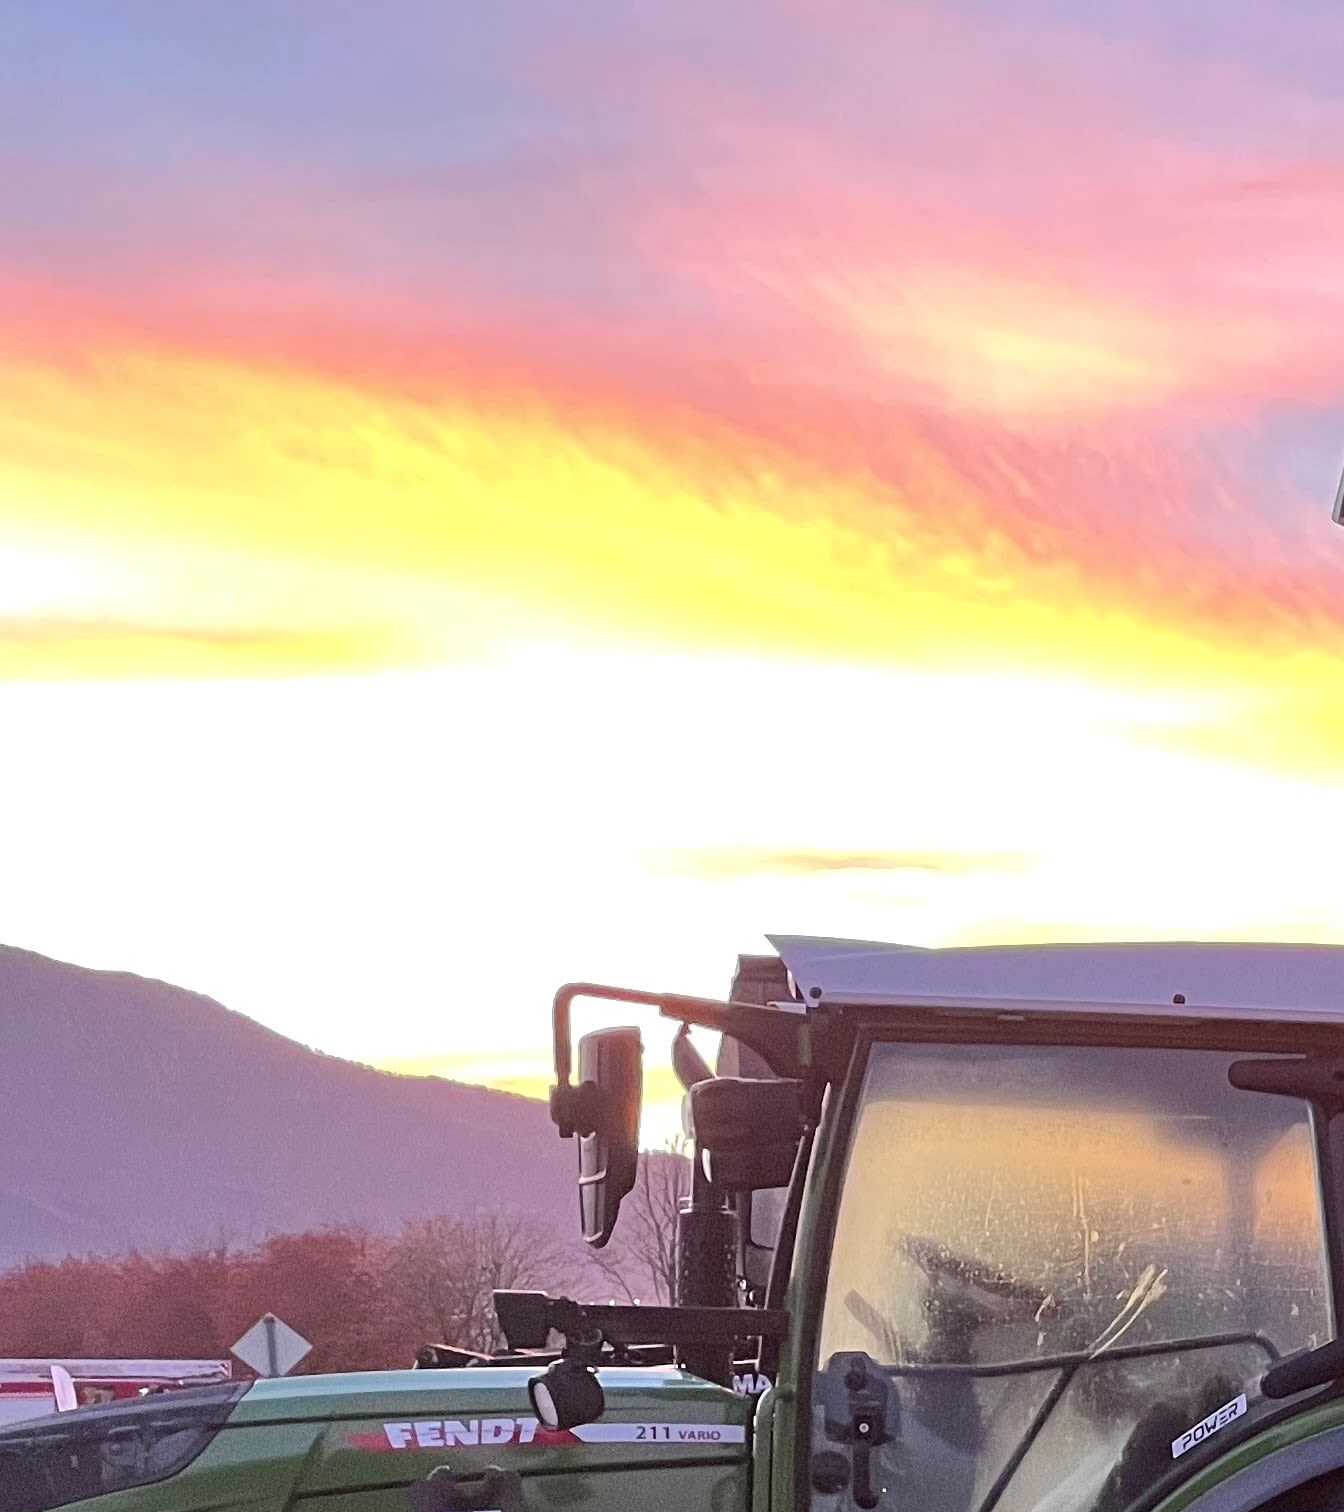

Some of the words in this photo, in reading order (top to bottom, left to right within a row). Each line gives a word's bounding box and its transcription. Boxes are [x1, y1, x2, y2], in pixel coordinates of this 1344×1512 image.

[384, 1417, 540, 1449] FENDT
[635, 1425, 670, 1440] 211
[678, 1430, 721, 1441] VARIO
[1181, 1402, 1238, 1450] POWER
